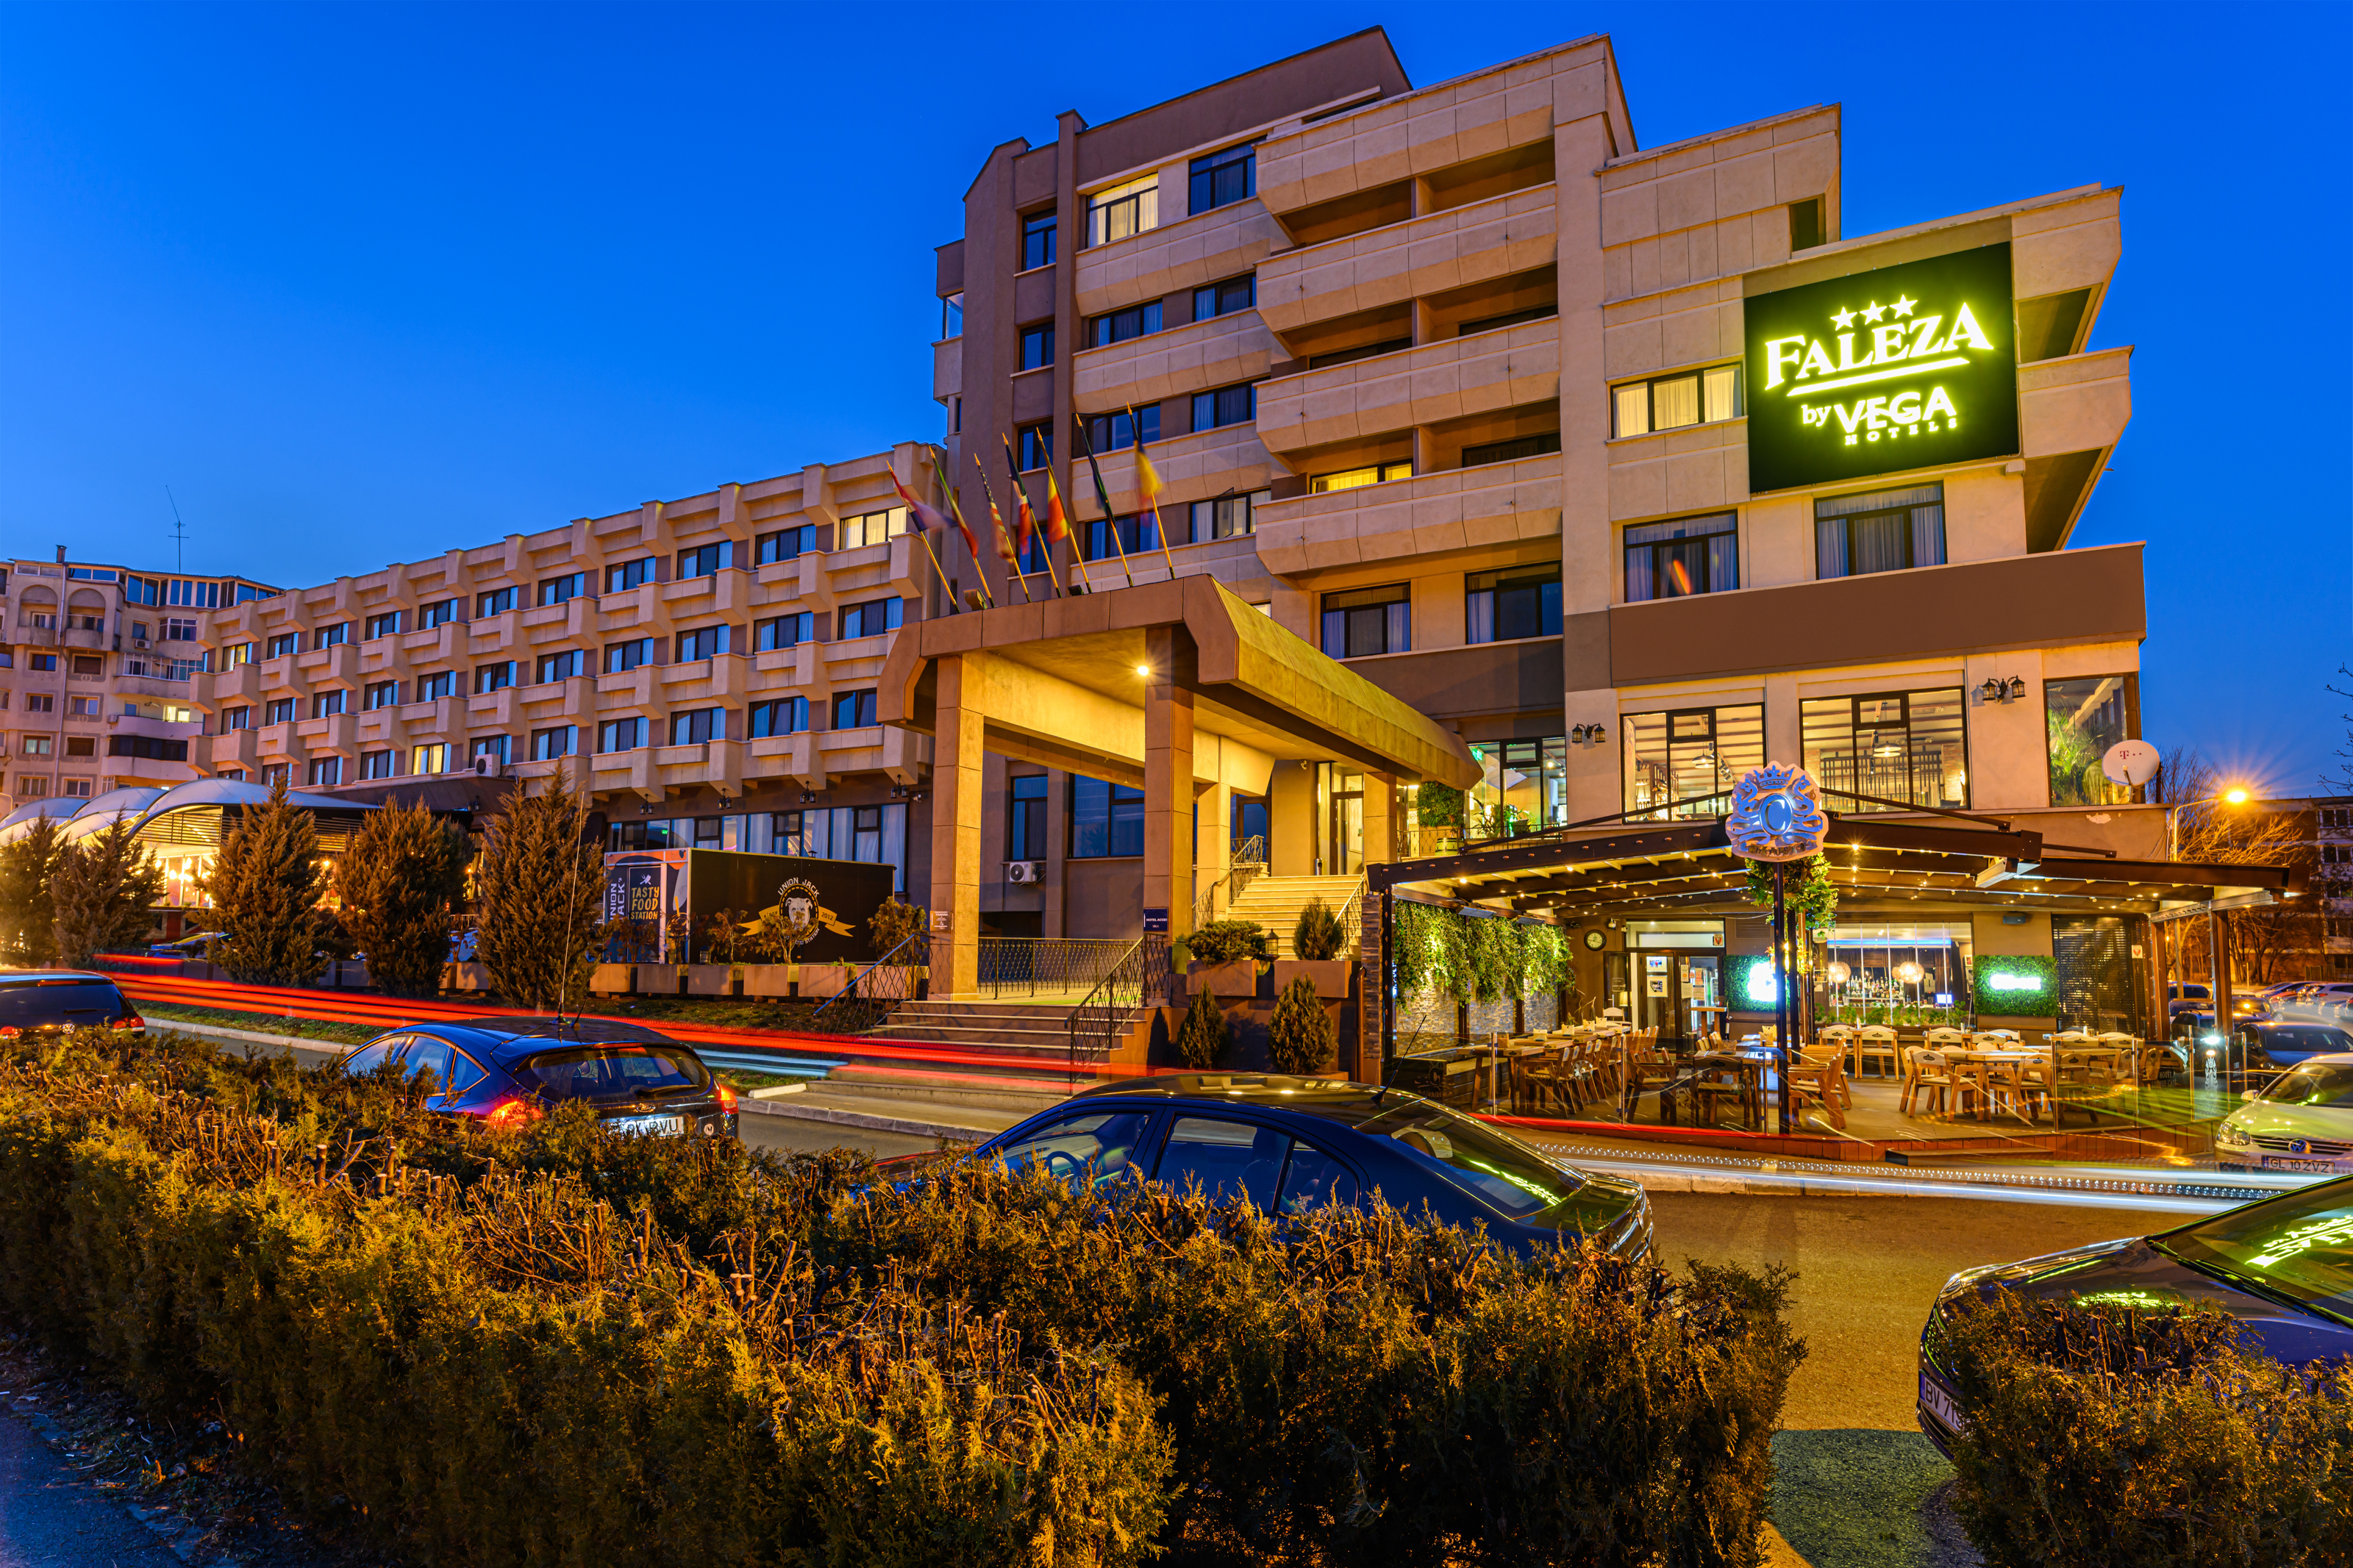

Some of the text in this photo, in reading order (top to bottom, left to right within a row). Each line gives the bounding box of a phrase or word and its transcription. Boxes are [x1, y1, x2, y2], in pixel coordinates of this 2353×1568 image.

[1765, 302, 1993, 390] FALEZA
[1802, 386, 1957, 433] by VEGA
[1845, 418, 1957, 445] HOTELS
[1765, 799, 1786, 832] C
[632, 887, 660, 898] TASTY
[777, 877, 821, 898] UNION JACK
[632, 898, 658, 911] FOOD
[630, 911, 658, 920] STATION
[821, 912, 834, 921] 2012
[2270, 1159, 2329, 1174] GL 10 ZVZ
[1926, 1380, 1940, 1409] BV
